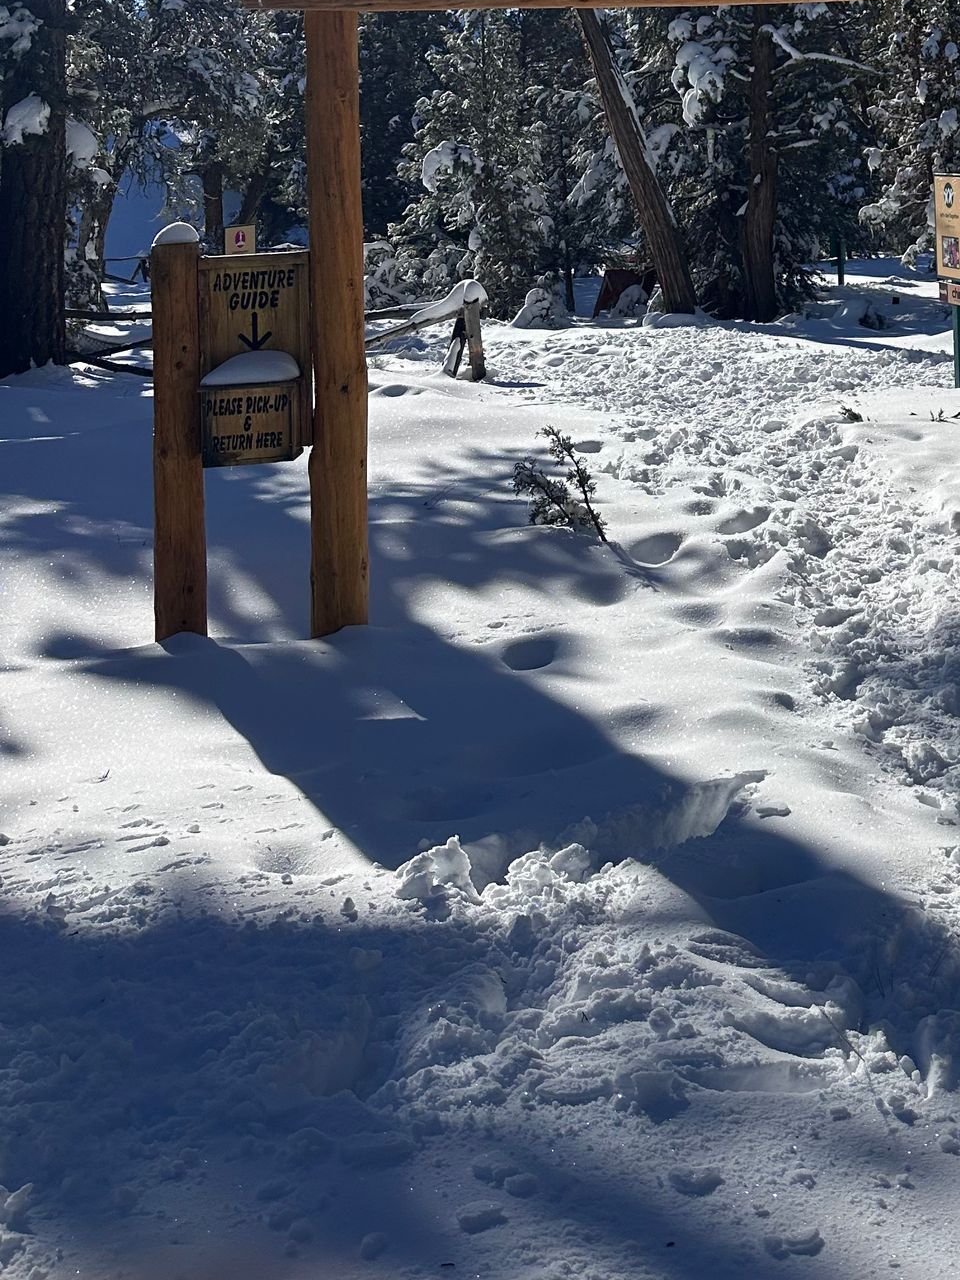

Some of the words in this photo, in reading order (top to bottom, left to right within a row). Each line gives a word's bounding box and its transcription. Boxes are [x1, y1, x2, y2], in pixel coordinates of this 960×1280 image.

[213, 269, 296, 293] ADVENTURE
[229, 290, 280, 311] GUIDE
[206, 396, 244, 418] PLEASE
[245, 393, 289, 415] PICK-UP
[243, 415, 253, 432] &
[212, 433, 254, 453] RETURN
[256, 431, 284, 450] HERE
